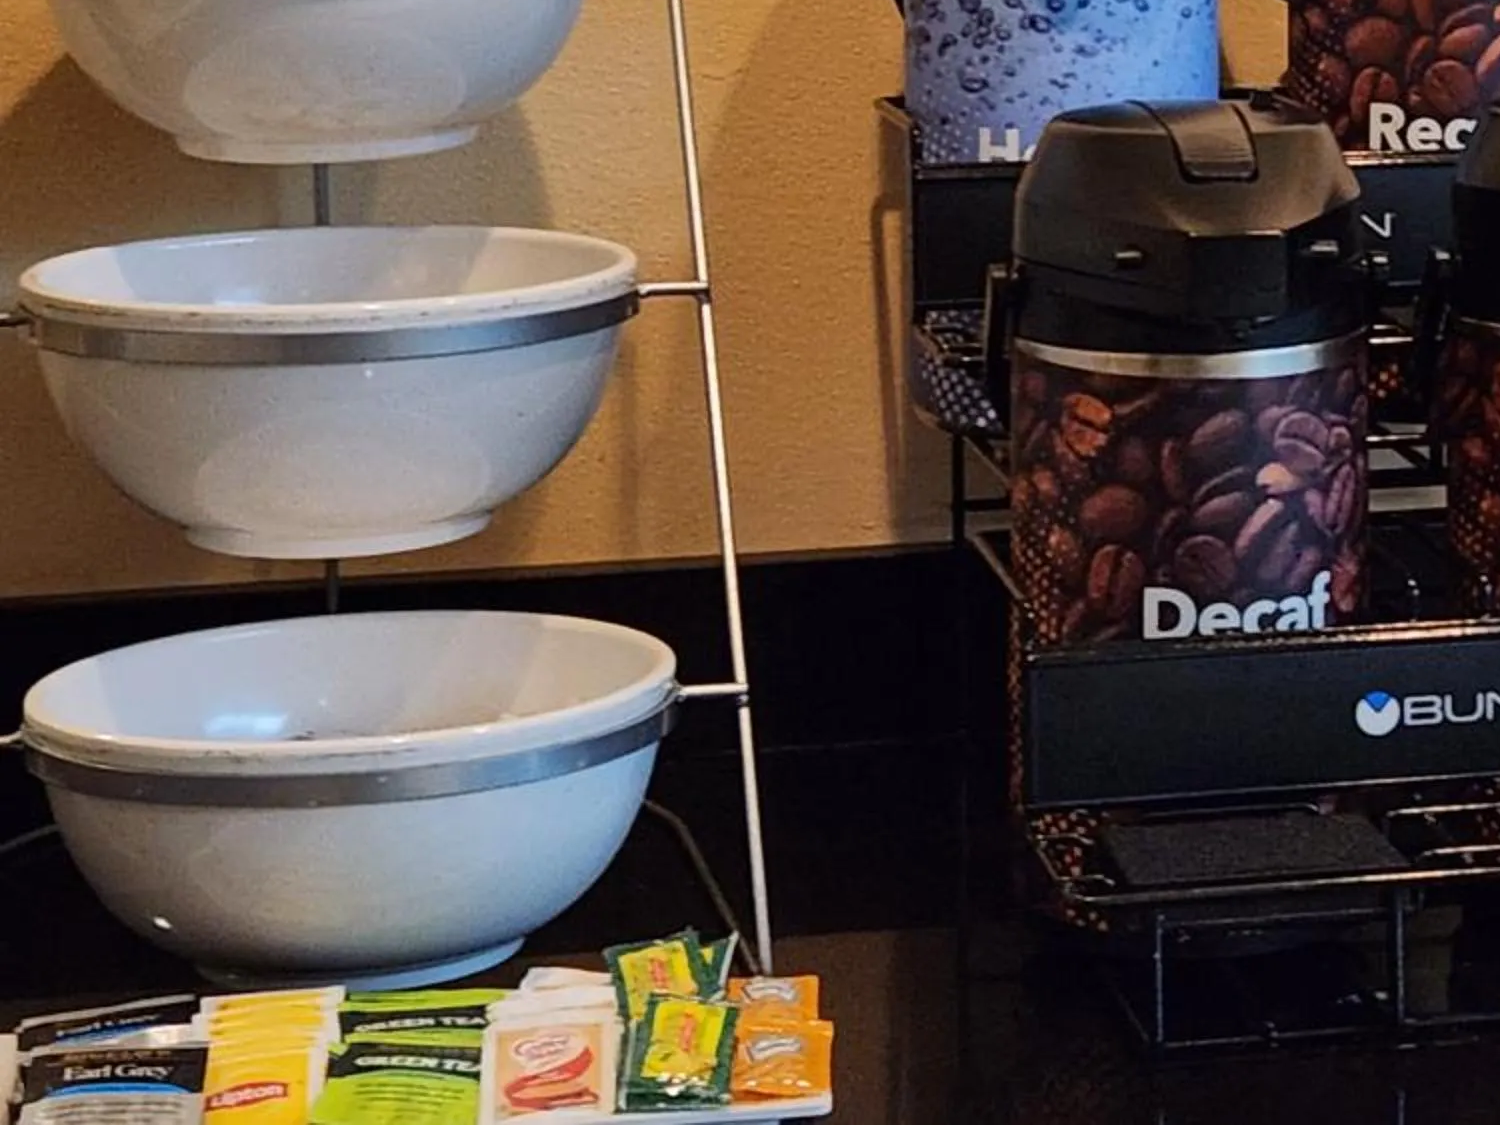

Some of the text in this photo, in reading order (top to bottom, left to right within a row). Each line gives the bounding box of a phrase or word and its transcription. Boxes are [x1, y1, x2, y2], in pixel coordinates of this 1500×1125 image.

[1143, 570, 1331, 640] Decaf
[63, 1063, 174, 1081] Earl Grey
[209, 1085, 285, 1108] Lipton
